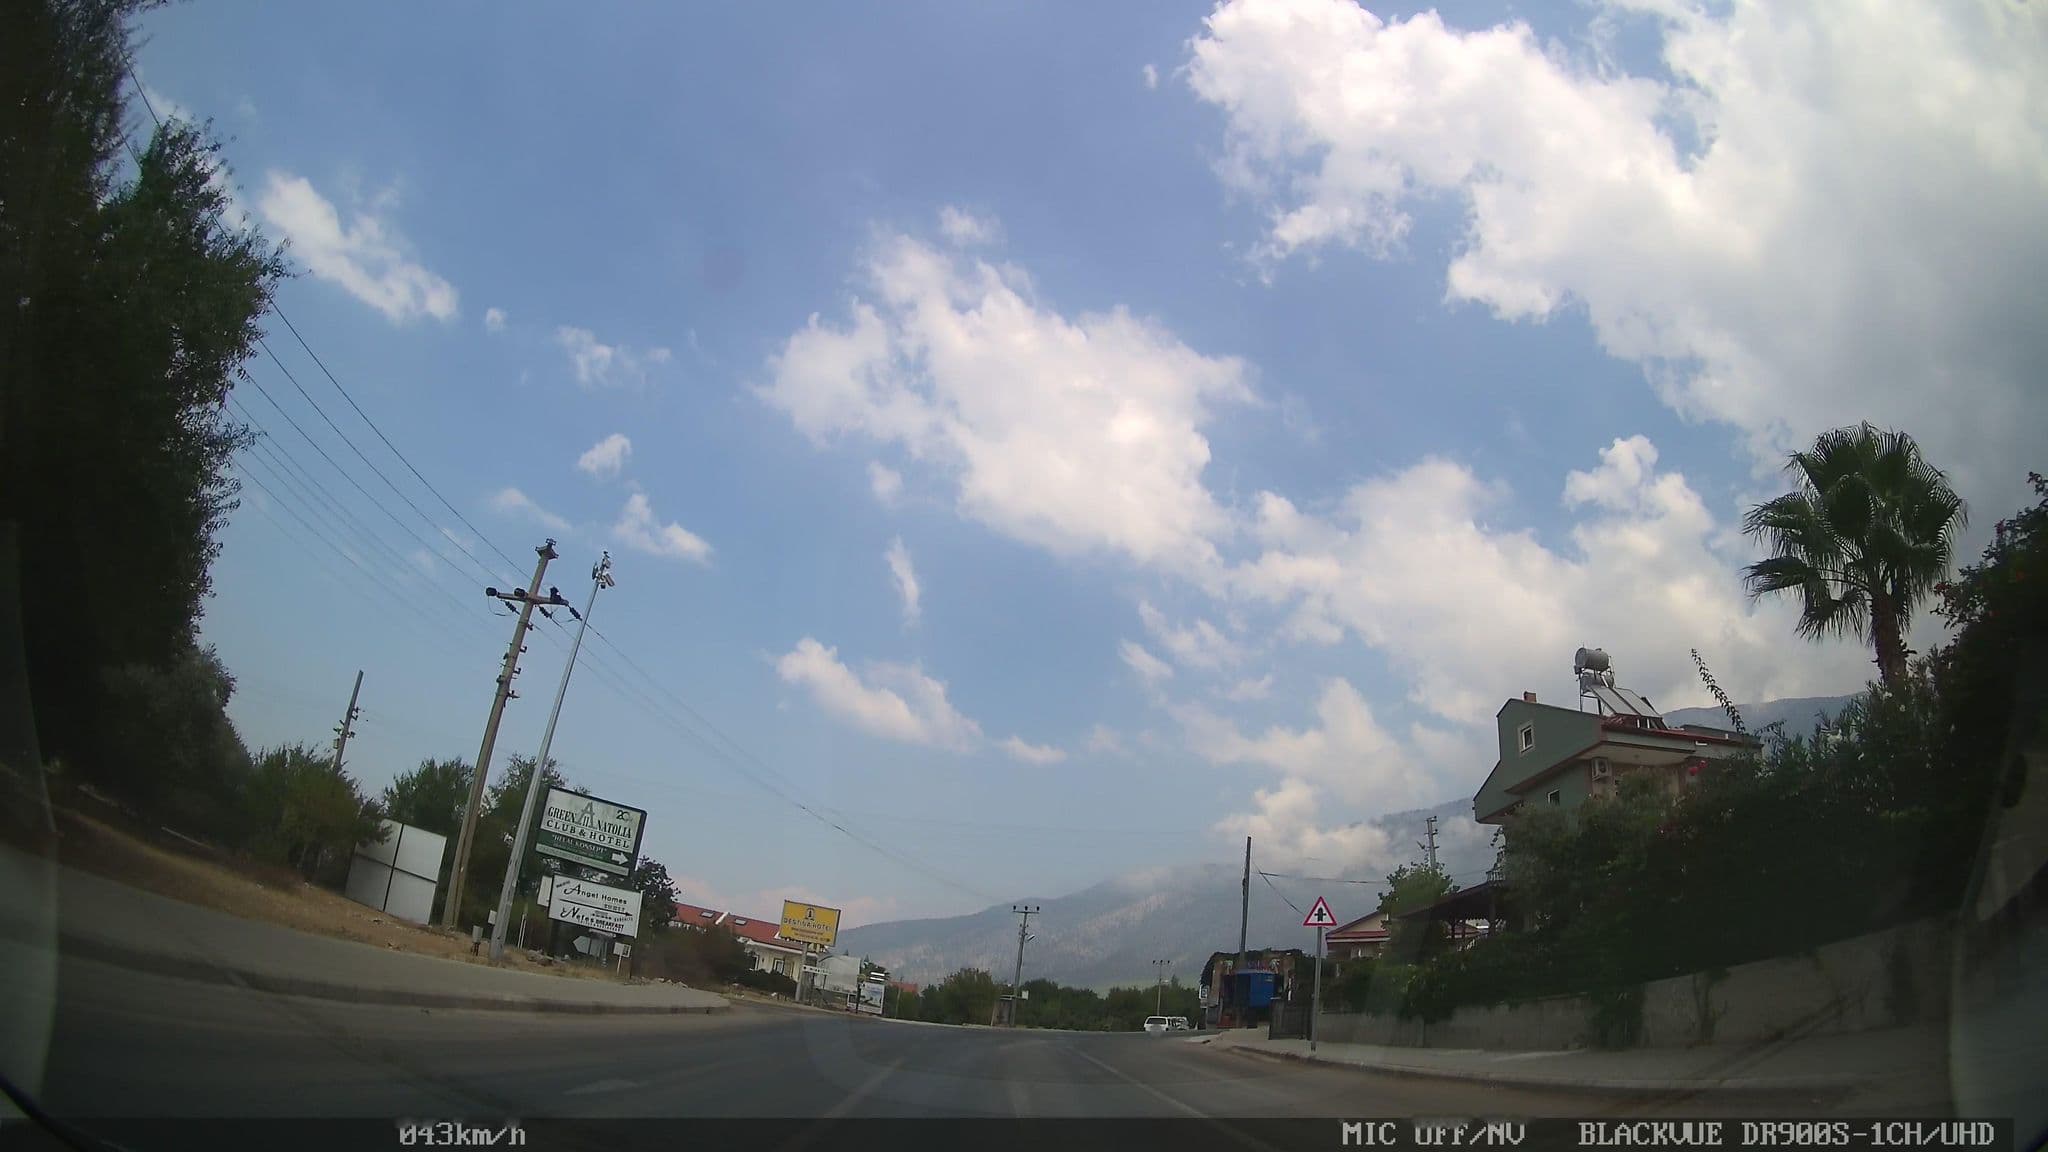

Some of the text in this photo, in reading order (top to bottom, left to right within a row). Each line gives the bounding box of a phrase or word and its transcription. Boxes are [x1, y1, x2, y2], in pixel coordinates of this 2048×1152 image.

[548, 806, 576, 823] GREEN
[546, 819, 629, 849] CLUB & HOTEL
[563, 883, 599, 899] Angel
[601, 894, 627, 905] Homes
